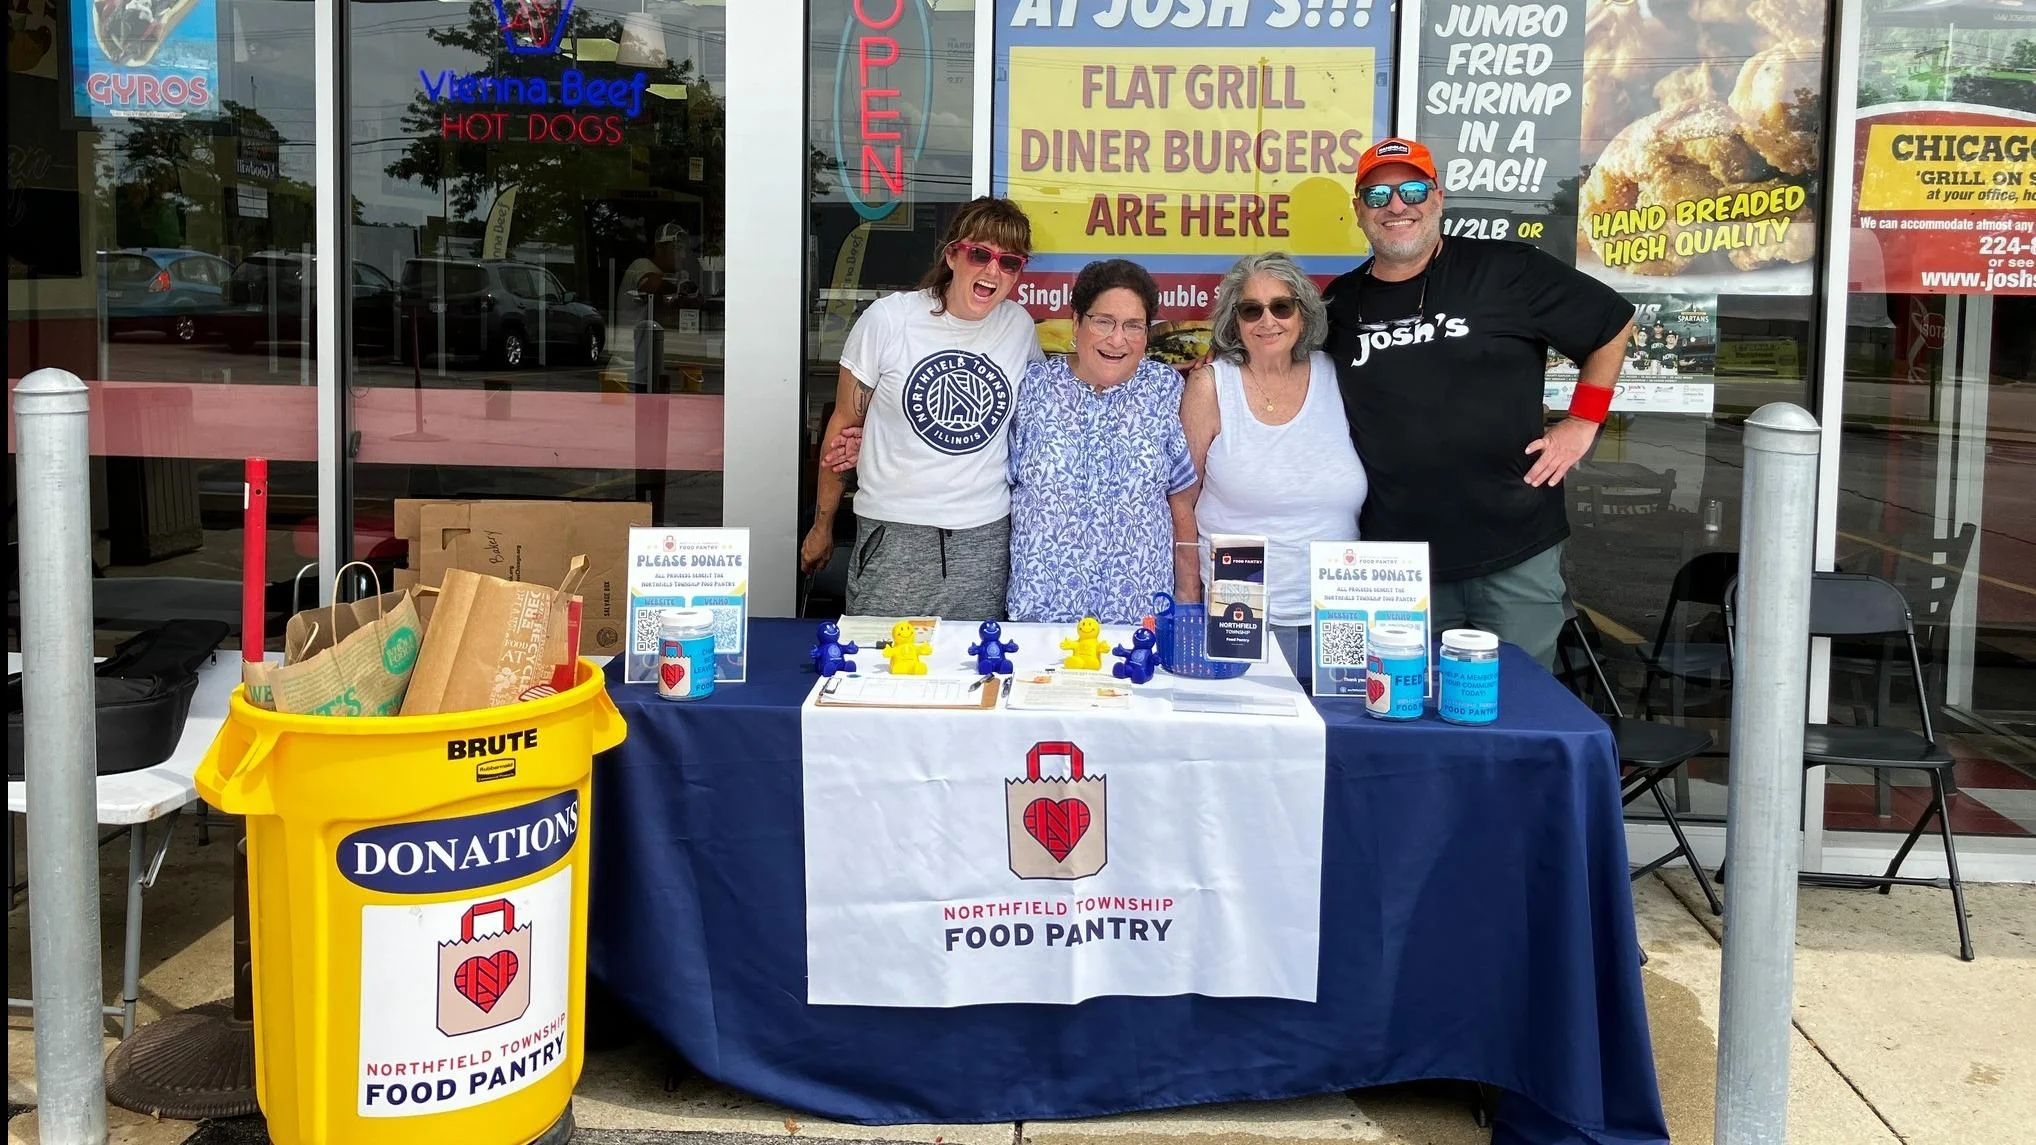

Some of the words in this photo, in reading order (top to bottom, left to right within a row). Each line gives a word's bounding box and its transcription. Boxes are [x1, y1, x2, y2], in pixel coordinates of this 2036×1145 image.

[1434, 4, 1568, 38] JUMBO
[1446, 42, 1553, 77] FRIED
[86, 73, 210, 106] GYROS
[419, 68, 548, 104] Vienna
[561, 69, 649, 118] Beef
[1081, 64, 1177, 109] FLAT
[1185, 64, 1306, 109] GRILL
[1425, 81, 1572, 115] SHRIMP
[442, 113, 510, 142] HOT
[529, 113, 624, 144] DOGS
[1457, 120, 1500, 154] IN
[1507, 120, 1536, 154] A
[1020, 128, 1151, 173] DINER
[1163, 128, 1364, 174] BURGERS
[1891, 133, 2036, 163] CHICAG
[1445, 157, 1548, 194] BAG!!
[1992, 171, 2023, 186] ON
[1591, 204, 1667, 239] HAND
[1675, 185, 1806, 228] BREADED
[1926, 189, 1940, 200] at
[1943, 190, 1975, 203] your
[1977, 189, 2019, 203] office,
[1085, 193, 1167, 236] ARE
[1180, 193, 1290, 237] HERE
[1517, 222, 1544, 239] OR
[1860, 217, 1877, 230] We
[1879, 219, 1898, 230] can
[1900, 218, 1974, 231] accommodate
[1976, 218, 2012, 231] almost
[2014, 221, 2033, 233] any
[1603, 233, 1667, 267] HIGH
[1675, 216, 1792, 257] QUALITY
[1988, 258, 2004, 268] or
[2008, 257, 2035, 268] see
[1157, 284, 1208, 307] ouble
[1677, 315, 1709, 323] SPARTANS
[1351, 312, 1470, 367] Josh's
[973, 359, 1007, 426] TOWNSHIP
[933, 430, 981, 445] ILLINOIS
[484, 530, 504, 564] Bakery
[637, 554, 687, 567] PLEASE
[691, 554, 742, 567] DONATE
[1318, 567, 1368, 580] PLEASE
[1372, 568, 1423, 582] DONATE
[1219, 621, 1258, 630] NORTHFIELD
[1327, 611, 1359, 620] WEBSITE
[1395, 674, 1423, 686] FEED
[1396, 703, 1417, 712] FOOD
[447, 728, 538, 760] BRUTE
[353, 801, 578, 875] DONATIONS
[944, 901, 1068, 920] NORTHFIELD
[1075, 896, 1174, 914] TOWNSHIP
[945, 922, 1035, 951] FOOD
[1045, 917, 1173, 948] PANTRY
[366, 1050, 492, 1076] NORTHFIELD
[500, 1012, 566, 1057] TOWNSHIP
[366, 1079, 457, 1106] FOOD
[469, 1031, 566, 1095] PANTRY
